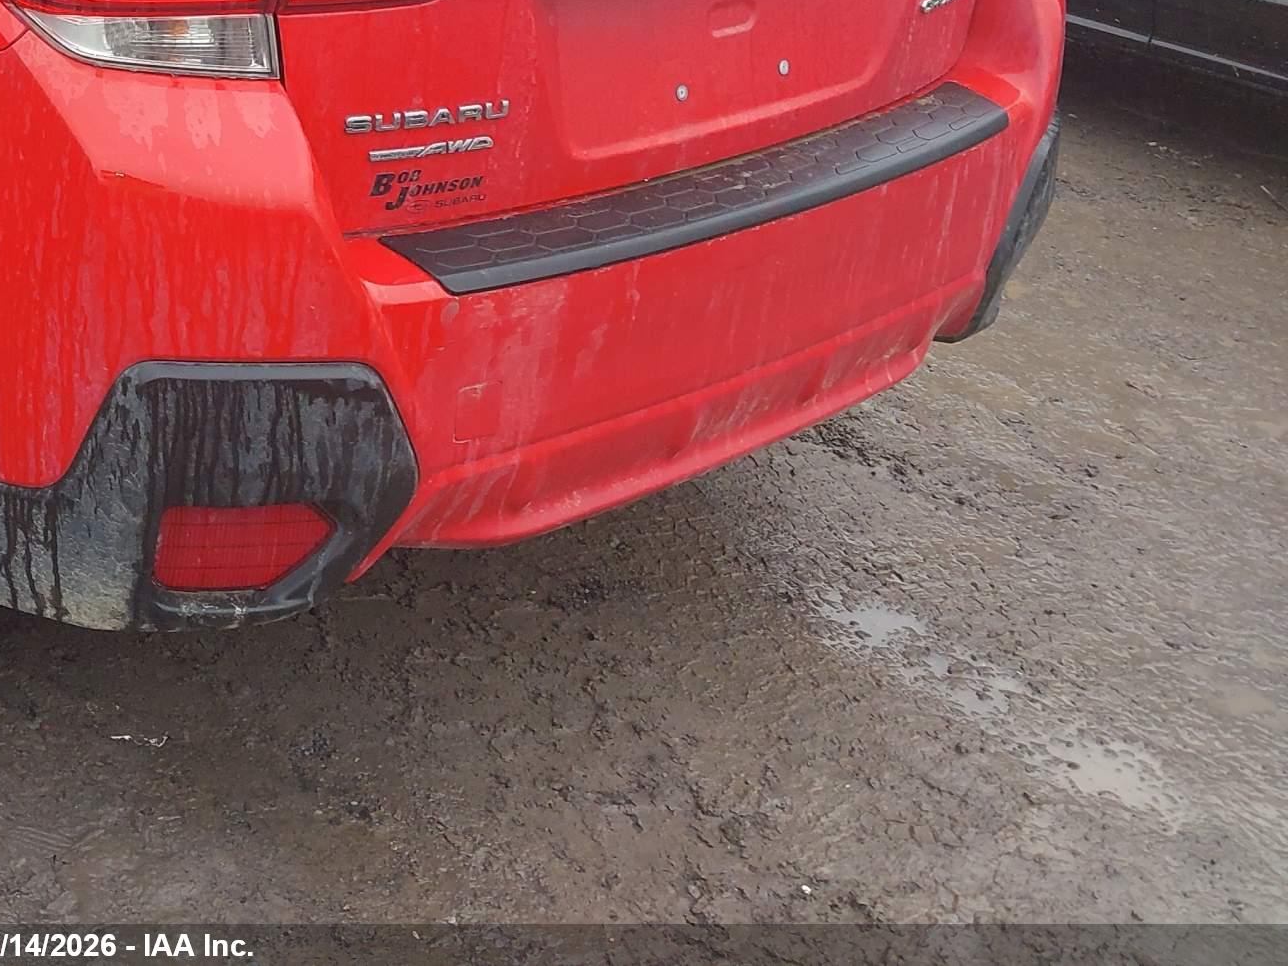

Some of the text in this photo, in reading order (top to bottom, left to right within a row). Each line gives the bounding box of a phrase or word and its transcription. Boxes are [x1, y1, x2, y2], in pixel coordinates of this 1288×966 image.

[344, 99, 510, 134] SUBARU
[414, 136, 494, 158] AWD
[369, 169, 422, 197] BOB
[385, 176, 484, 211] JOHNSON
[434, 194, 487, 208] SUBARU
